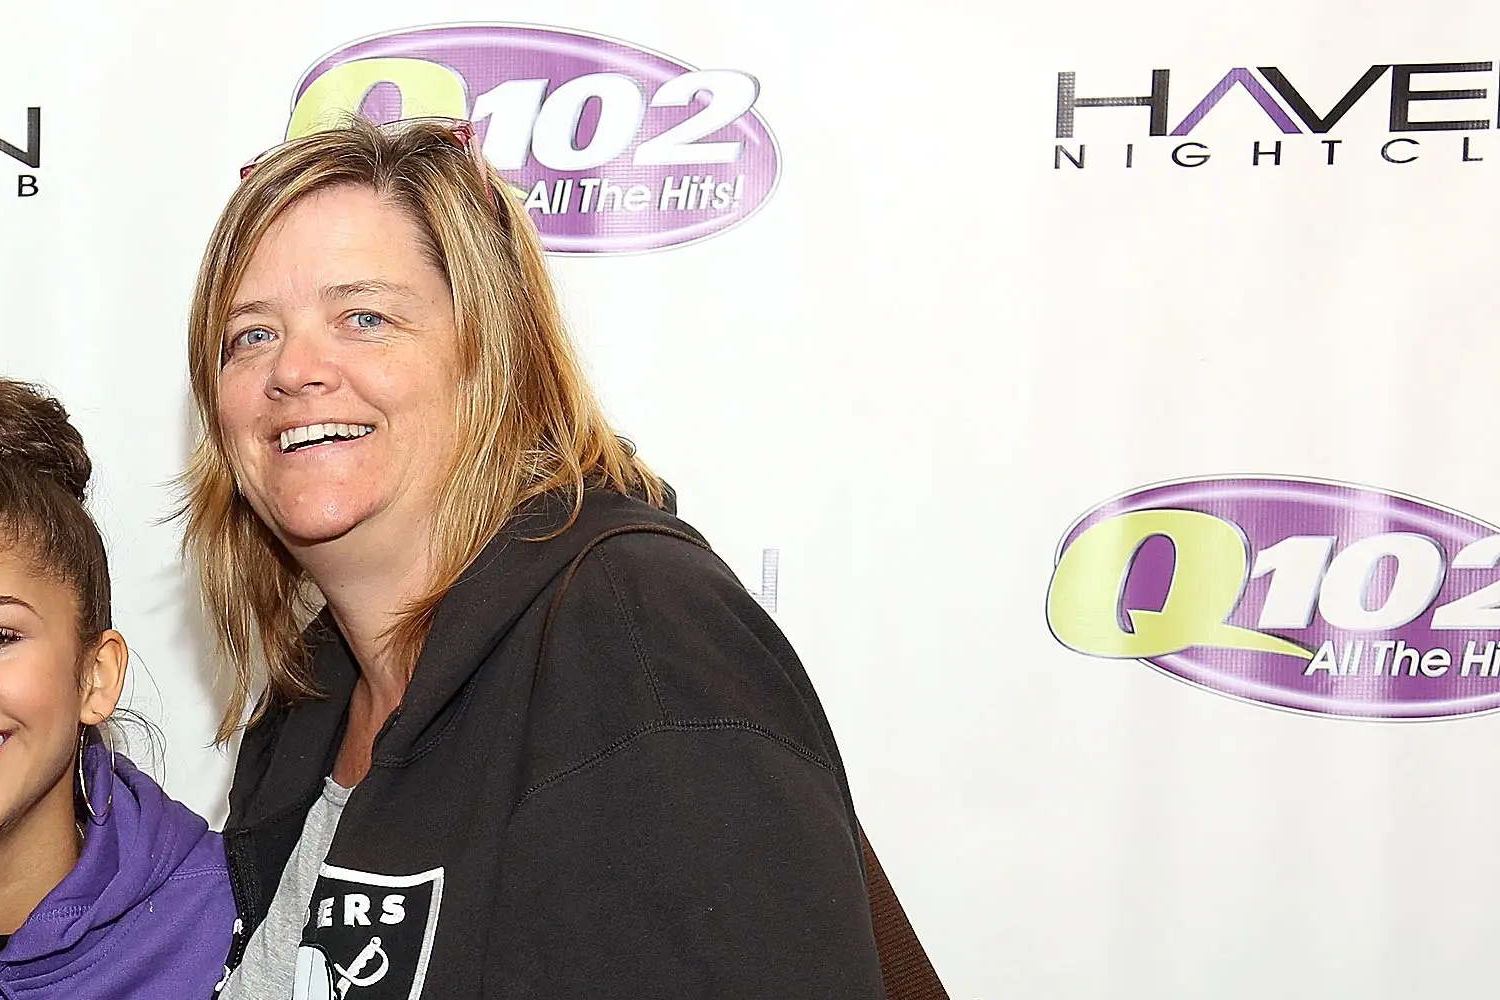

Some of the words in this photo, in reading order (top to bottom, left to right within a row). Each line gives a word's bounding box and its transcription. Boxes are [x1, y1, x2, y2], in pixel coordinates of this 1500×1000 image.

[1056, 61, 1500, 138] HAVE
[1053, 137, 1484, 169] NIGHTCL
[524, 179, 574, 214] All
[578, 177, 651, 213] The
[658, 174, 745, 211] Hits!
[1304, 640, 1354, 677] All
[1371, 640, 1452, 678] The
[303, 893, 406, 929] ERS
